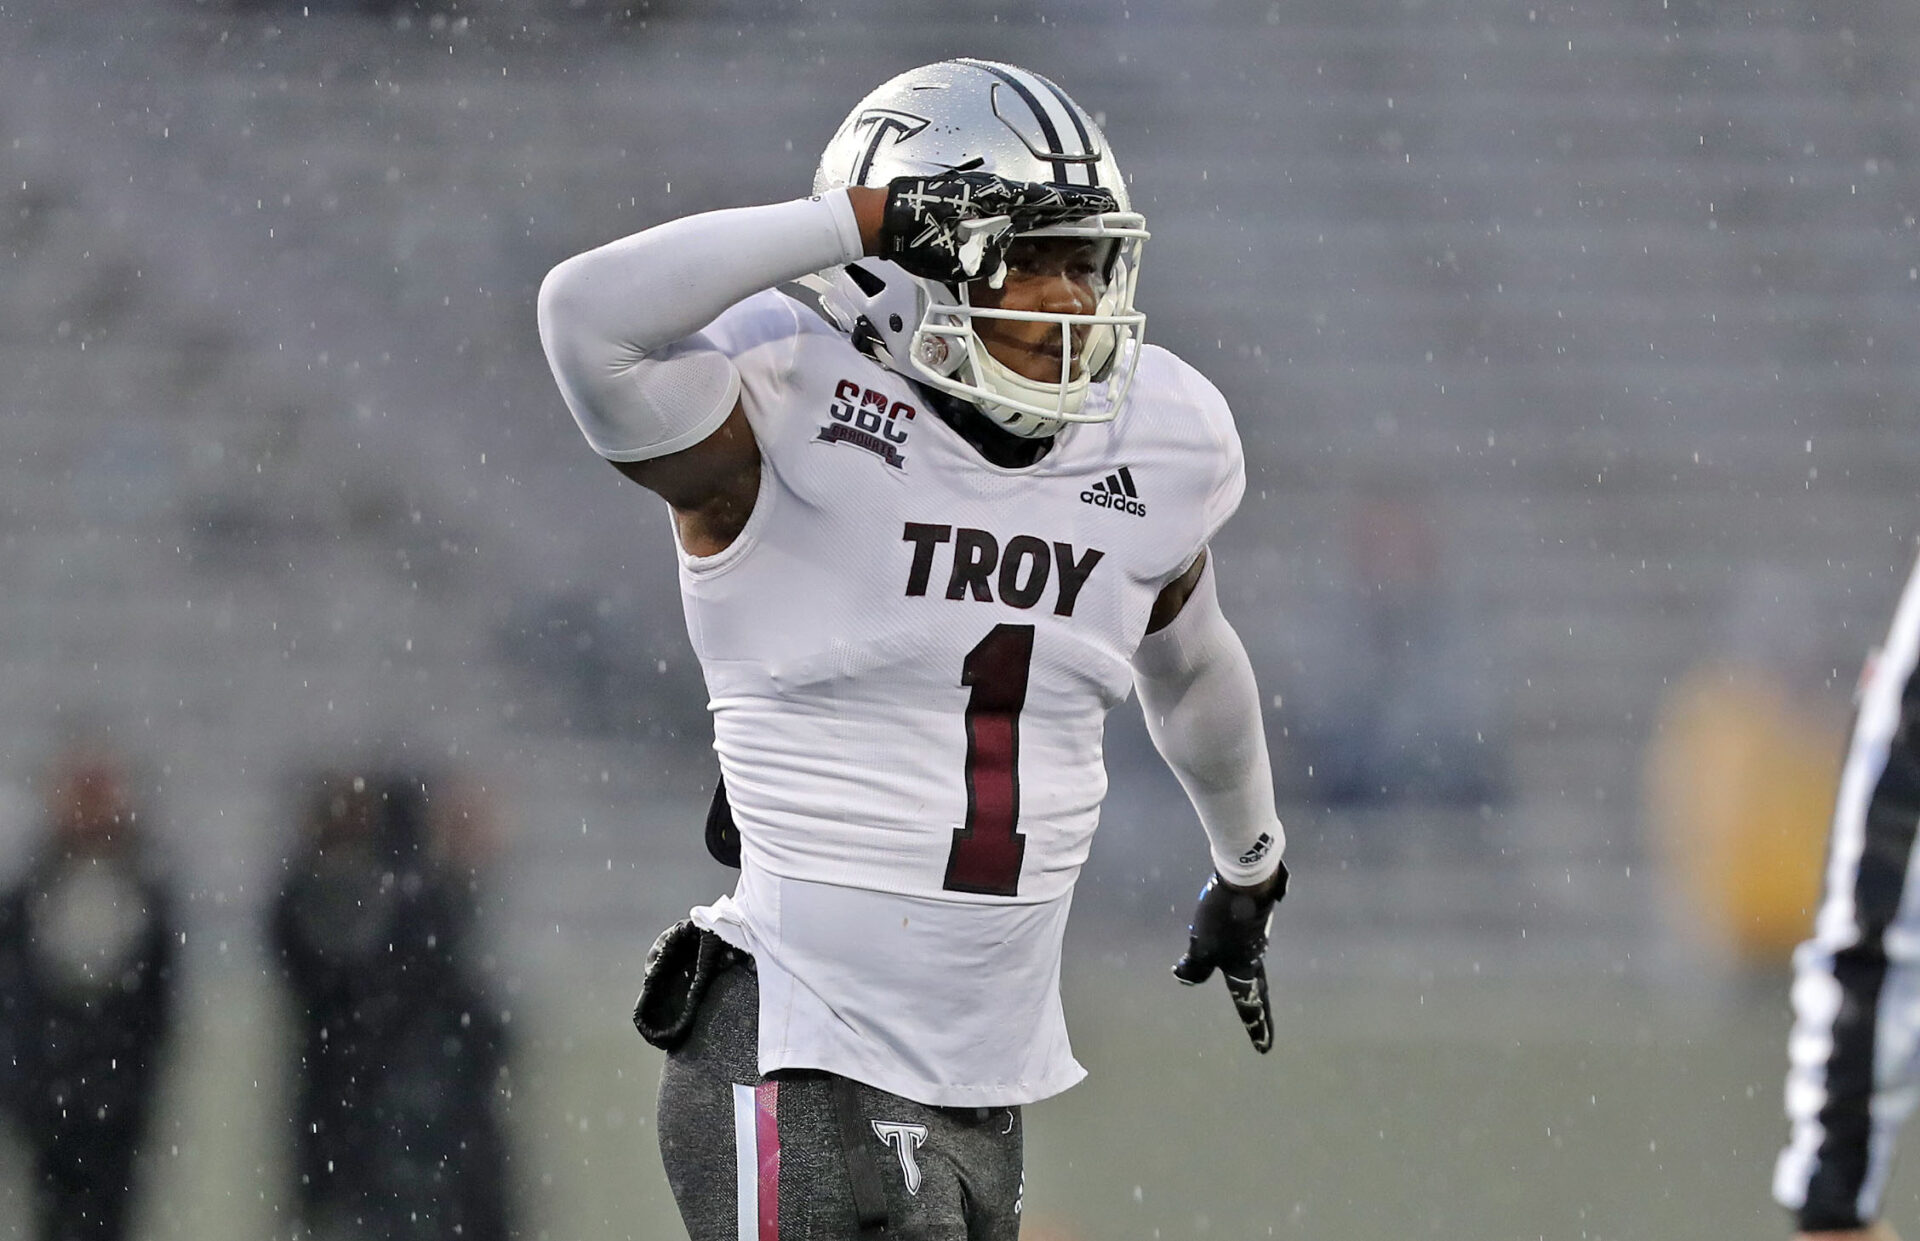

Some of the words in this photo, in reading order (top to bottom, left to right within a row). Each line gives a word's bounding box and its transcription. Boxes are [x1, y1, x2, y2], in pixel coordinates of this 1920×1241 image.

[830, 379, 916, 443] SBC
[1080, 491, 1146, 517] adidas
[902, 522, 1105, 617] TROY
[943, 623, 1035, 897] 1
[871, 1120, 928, 1195] T
